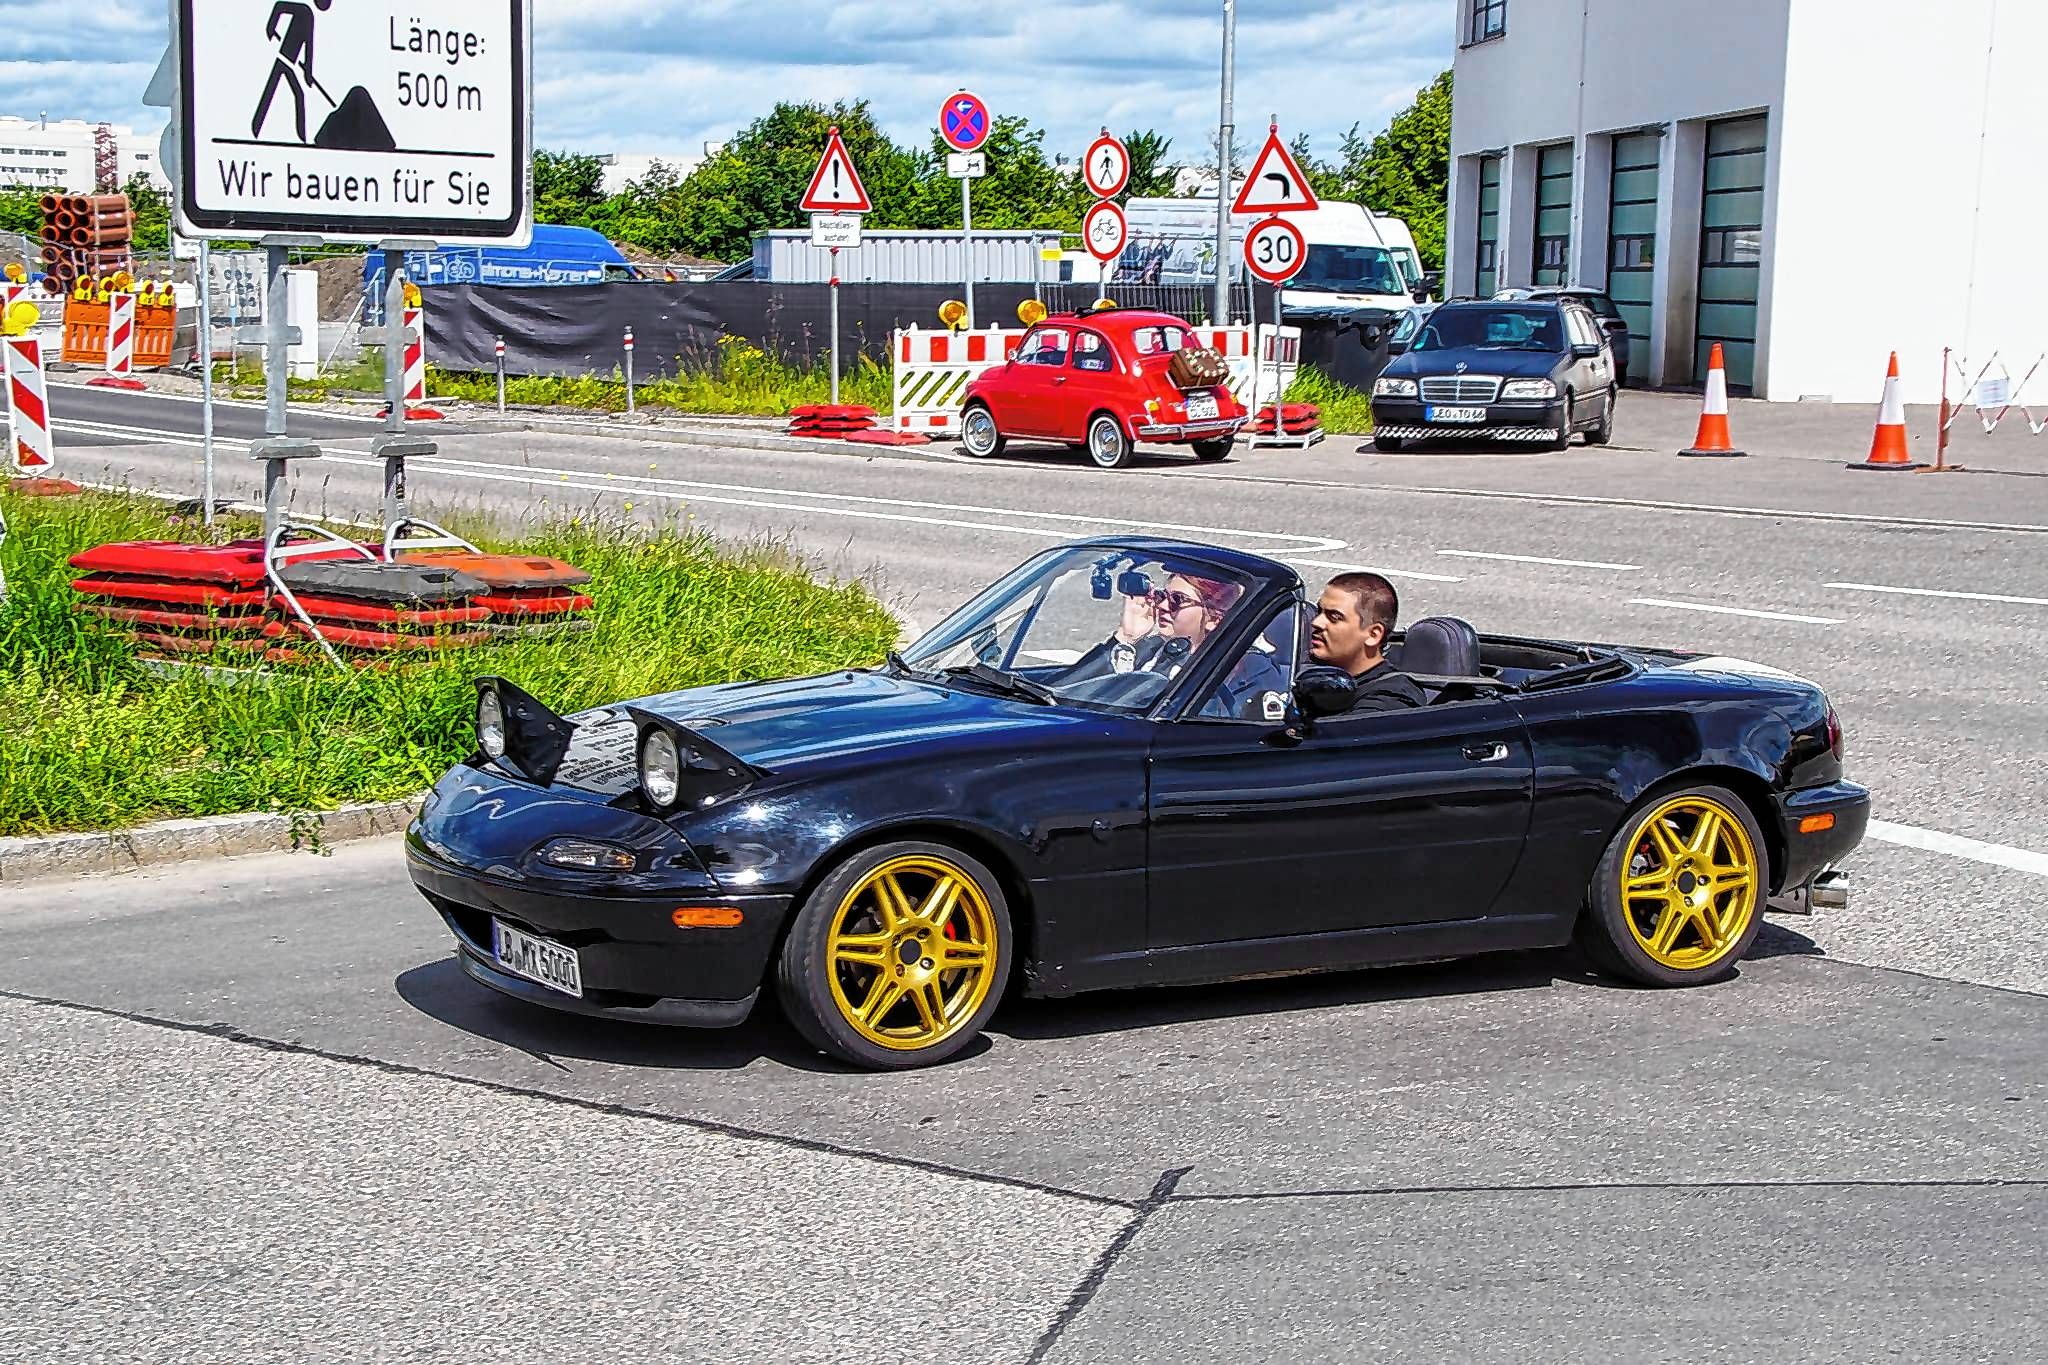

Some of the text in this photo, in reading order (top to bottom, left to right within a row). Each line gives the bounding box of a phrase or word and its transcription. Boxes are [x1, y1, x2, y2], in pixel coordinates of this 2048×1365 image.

[390, 15, 486, 65] Länge:
[397, 71, 482, 111] 500 m
[218, 158, 490, 206] Wir bauen für Sie
[1257, 235, 1292, 264] 30
